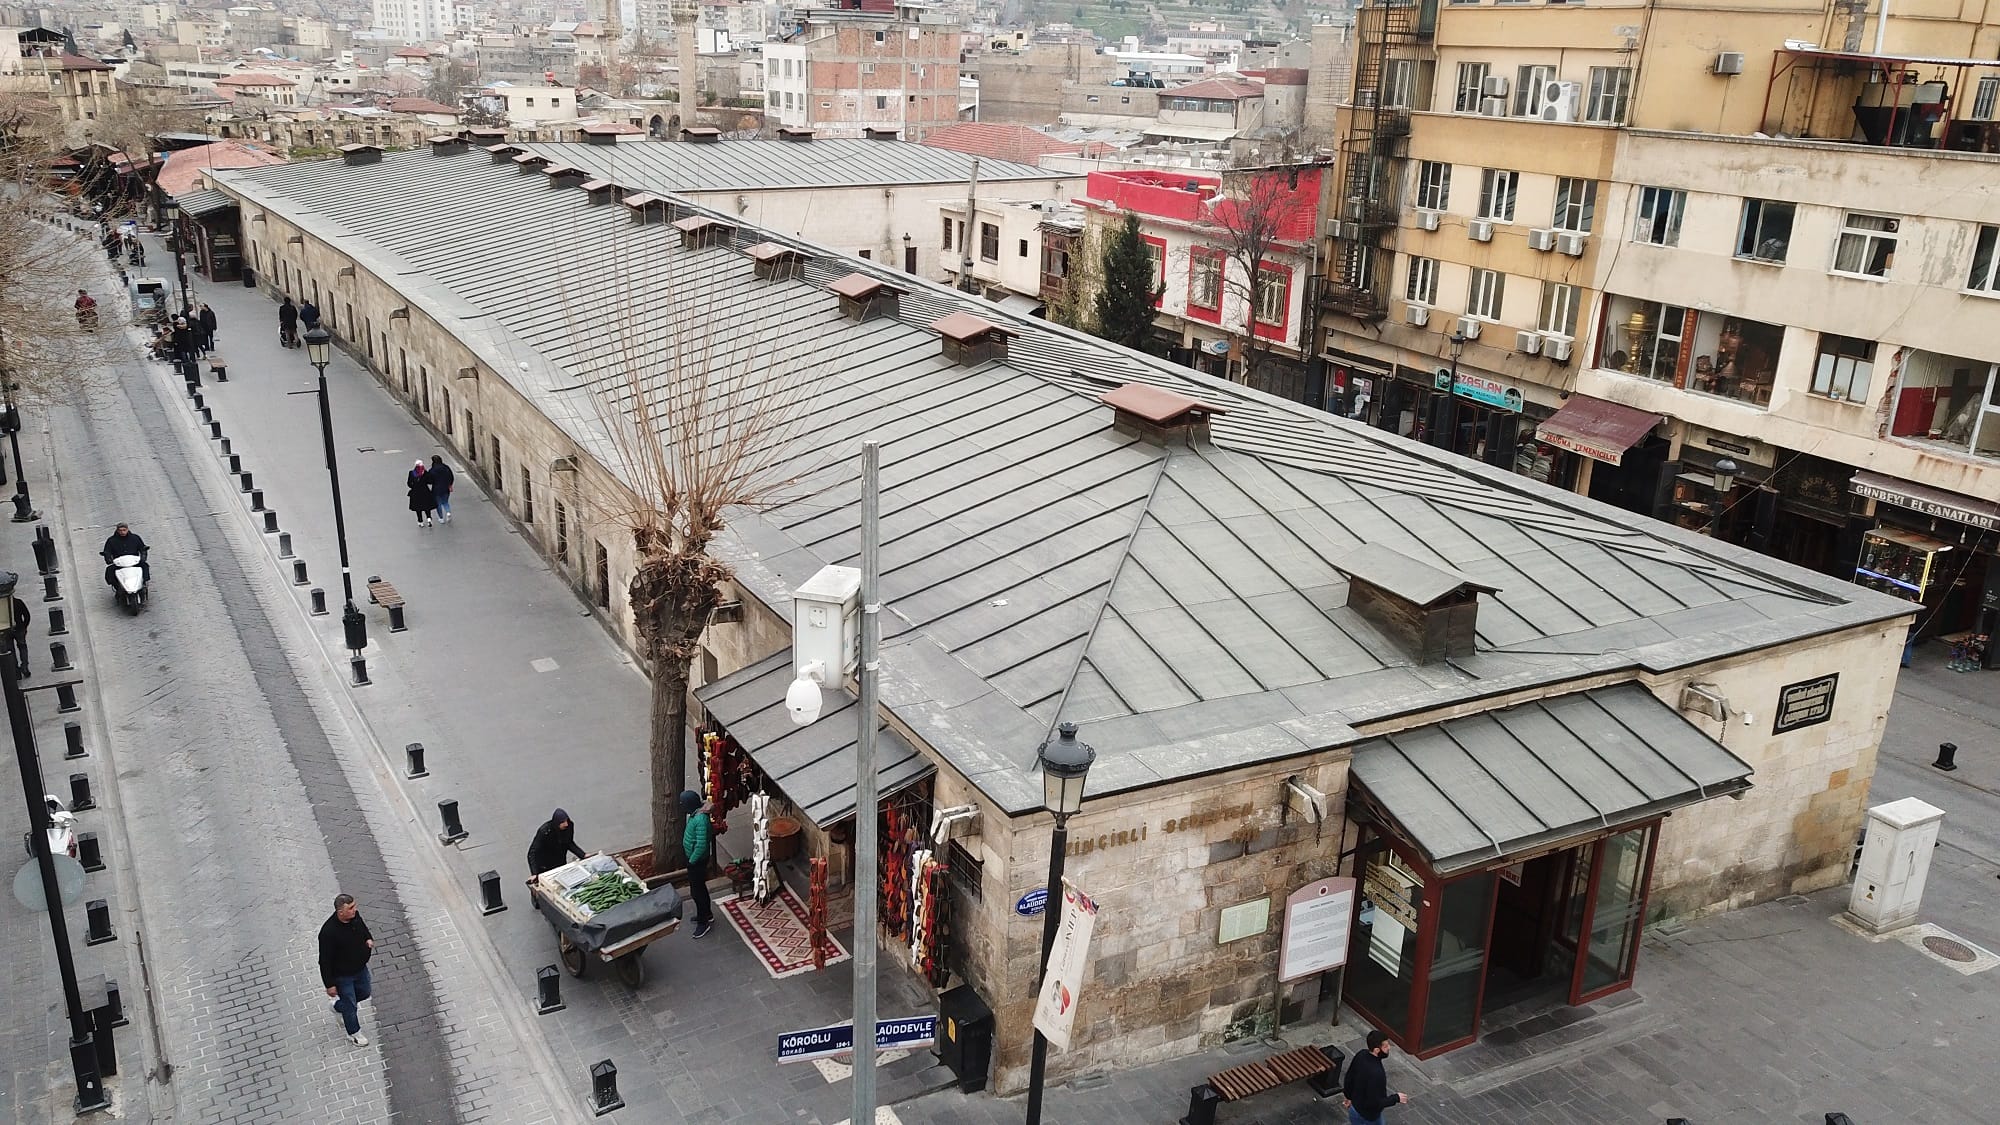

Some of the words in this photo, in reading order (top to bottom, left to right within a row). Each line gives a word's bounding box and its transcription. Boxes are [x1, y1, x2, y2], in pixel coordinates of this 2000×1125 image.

[1545, 433, 1571, 448] ZEUGMA
[1911, 499, 1924, 511] EL
[1927, 503, 1994, 528] SANATLARI
[783, 1032, 831, 1048] KÖROĞLU
